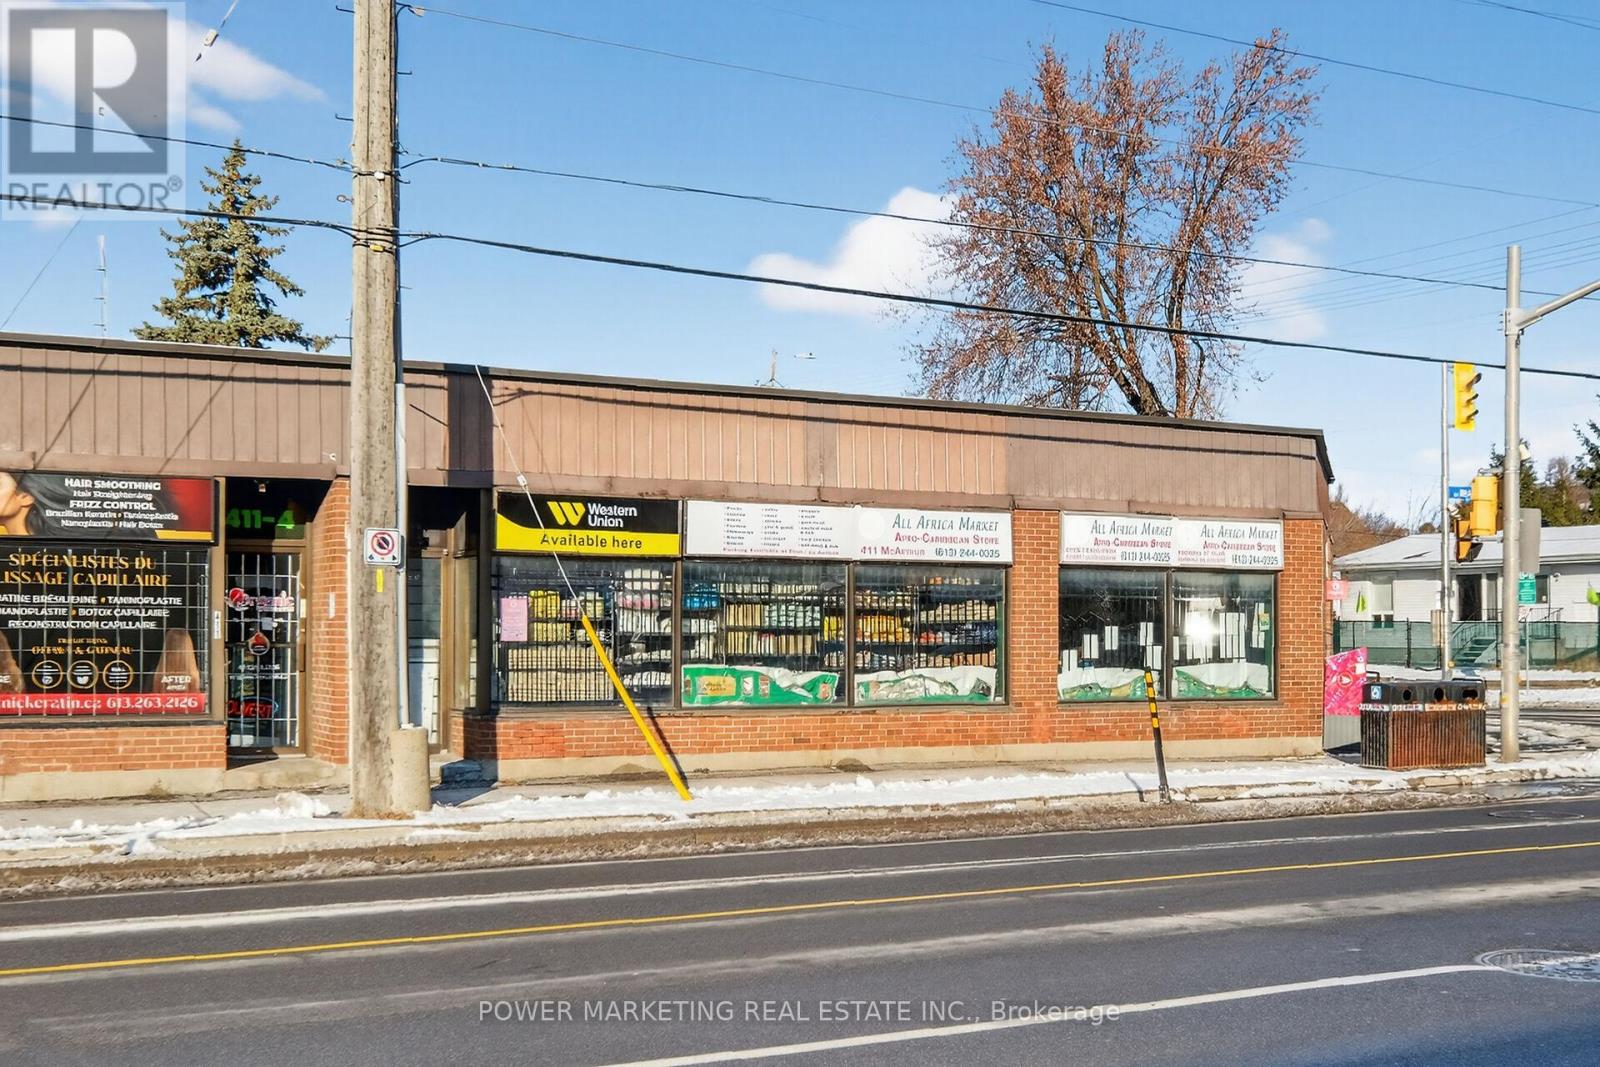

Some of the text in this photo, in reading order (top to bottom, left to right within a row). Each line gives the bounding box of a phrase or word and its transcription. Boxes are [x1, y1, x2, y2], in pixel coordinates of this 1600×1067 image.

[65, 478, 161, 491] HAIR SMOOTHING
[69, 500, 156, 511] FRIZZ CONTROL
[588, 502, 637, 517] Western
[227, 508, 295, 529] 411-4
[588, 515, 624, 528] Union
[917, 515, 954, 530] AFRICA
[958, 517, 999, 532] MARKET
[1141, 523, 1173, 536] MARKET
[1249, 526, 1277, 540] MARKET
[540, 534, 642, 549] Available here
[8, 551, 157, 569] SPÉCIALISTES DU
[0, 571, 172, 587] ISSAGE CAPILLAIRE
[78, 608, 113, 617] BOTOX
[114, 609, 170, 618] CAPILLAIRE
[8, 620, 158, 630] RECONSTRUCTION CAPILLAIRE
[161, 675, 191, 684] AFTER
[0, 696, 198, 709] nickeratin.ca 613.263.2126
